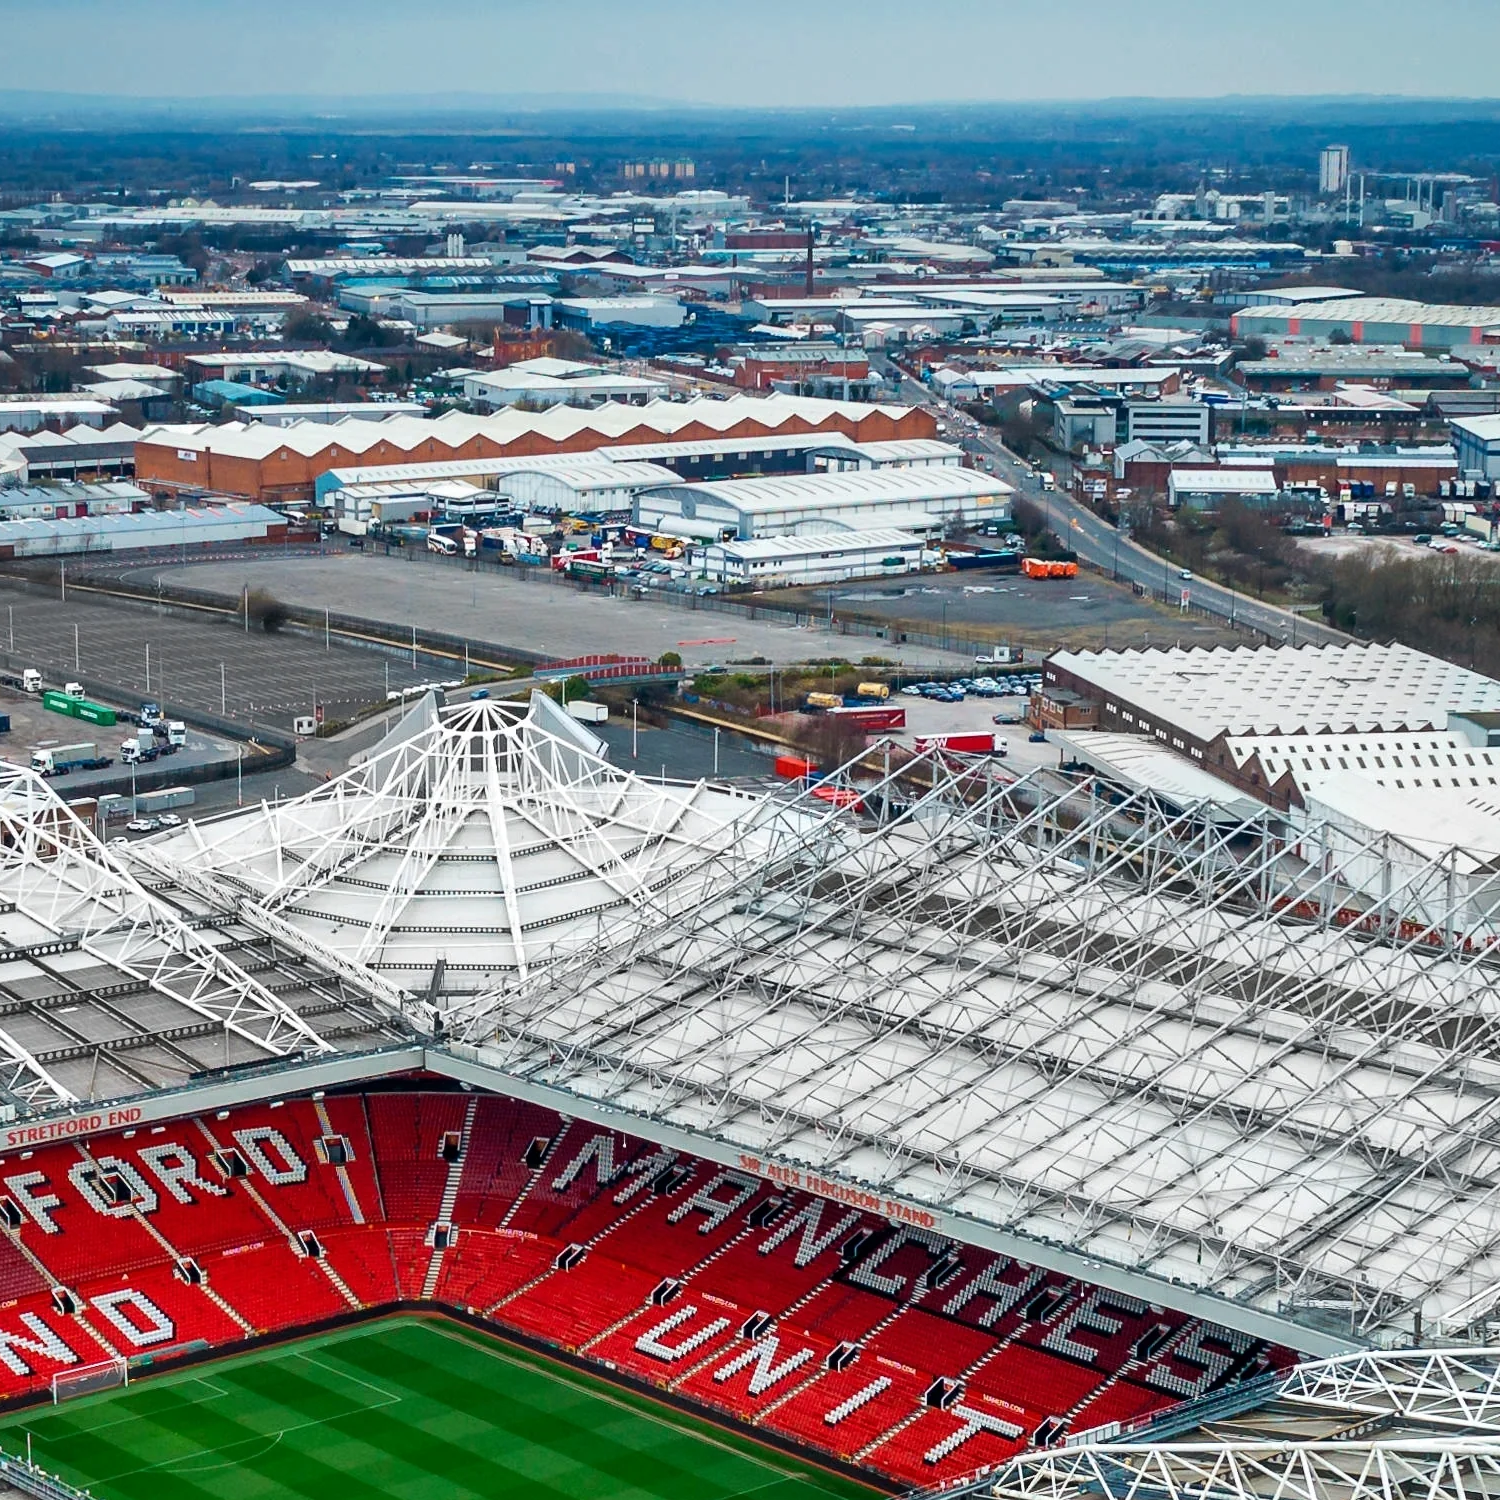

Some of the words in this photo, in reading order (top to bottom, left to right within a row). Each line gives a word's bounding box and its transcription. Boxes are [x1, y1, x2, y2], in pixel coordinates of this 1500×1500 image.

[7, 1115, 102, 1146] STRETFORD
[109, 1108, 141, 1126] END
[739, 1154, 761, 1172] SIR
[767, 1163, 800, 1186] ALEX
[806, 1175, 882, 1209] FERGUSON
[886, 1200, 936, 1229] STAND
[634, 1304, 1024, 1465] UNIT
